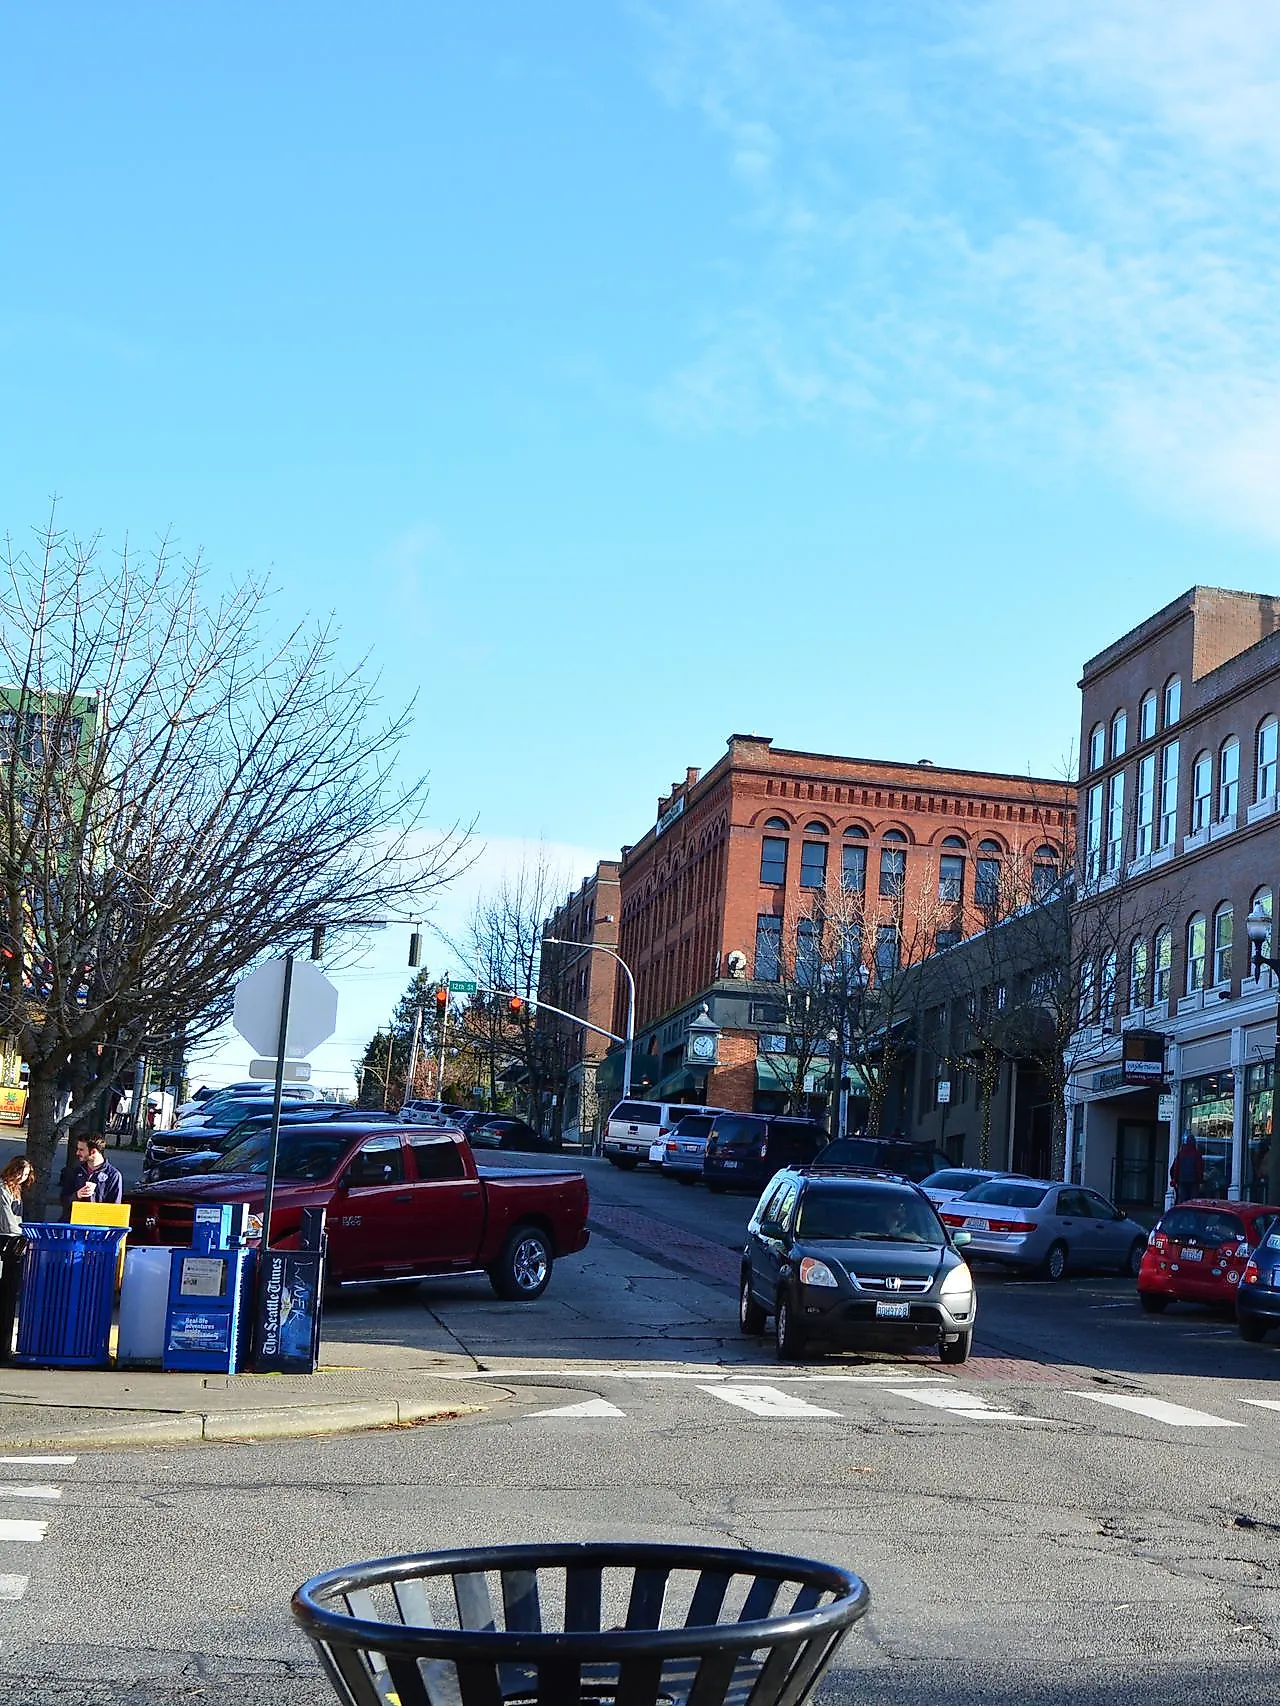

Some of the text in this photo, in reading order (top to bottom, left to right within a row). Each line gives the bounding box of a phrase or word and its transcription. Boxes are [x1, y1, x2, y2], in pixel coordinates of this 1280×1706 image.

[263, 1258, 282, 1355] The Seattle Times
